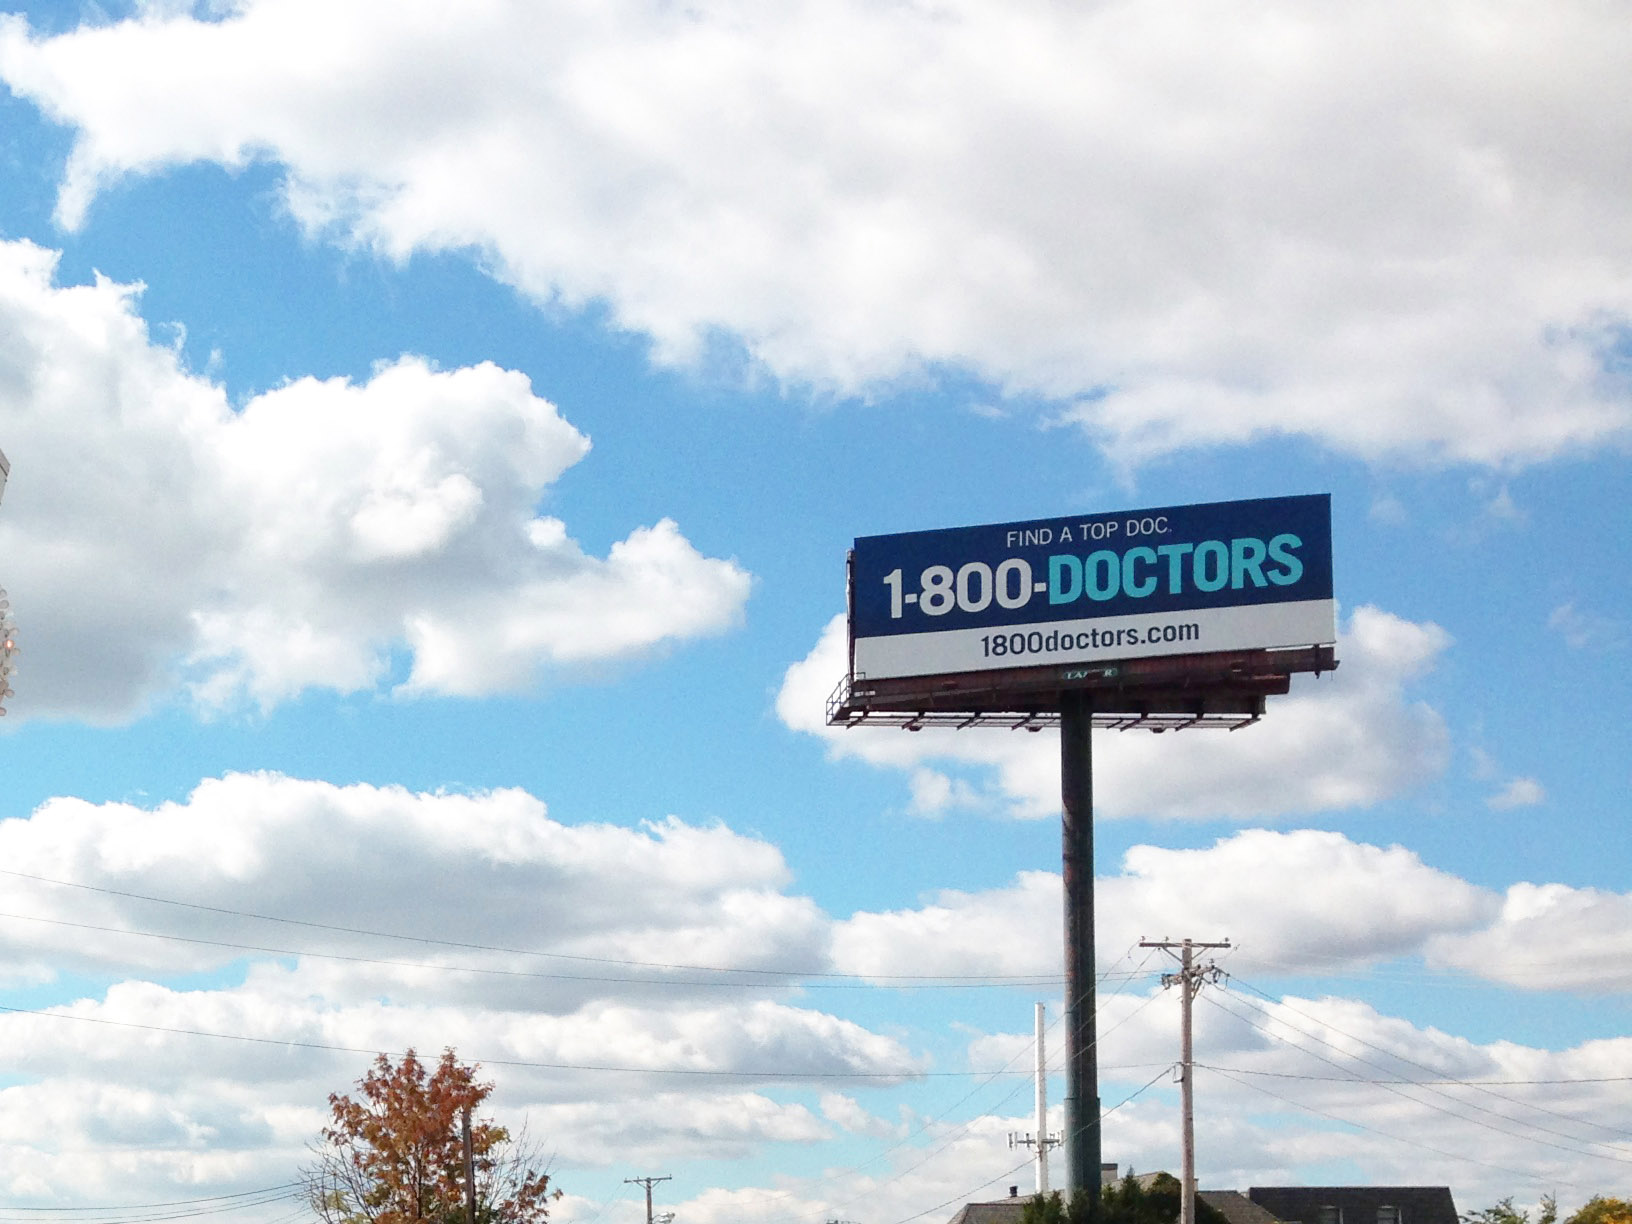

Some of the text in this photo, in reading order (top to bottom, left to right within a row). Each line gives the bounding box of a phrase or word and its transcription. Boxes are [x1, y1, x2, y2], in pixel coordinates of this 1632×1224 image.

[1007, 528, 1052, 548] FIND
[1060, 526, 1072, 543] A
[1080, 521, 1119, 542] TOP
[883, 533, 1304, 618] 1-800-DOCTORS
[981, 622, 1200, 657] 1800doctors.com
